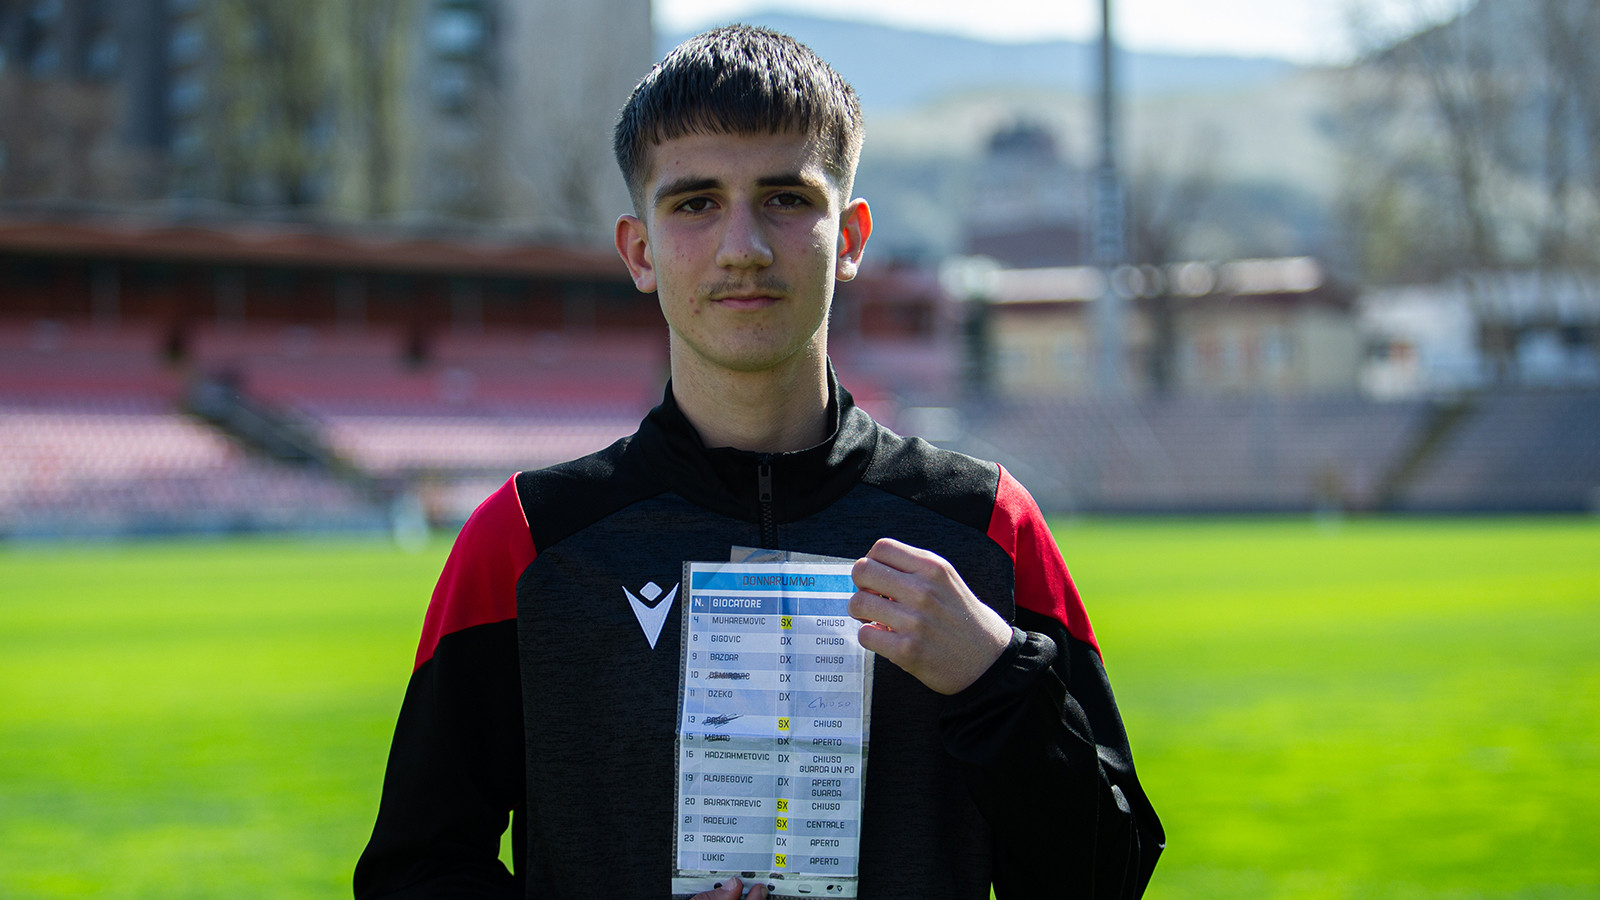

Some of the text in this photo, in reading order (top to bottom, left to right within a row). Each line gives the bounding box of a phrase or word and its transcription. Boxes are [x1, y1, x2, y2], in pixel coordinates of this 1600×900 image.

[743, 576, 815, 587] DONNARUMMA
[695, 599, 761, 608] N. GIOCATORE
[712, 617, 766, 625] MUHAREMOVIC
[781, 618, 792, 627] SX
[780, 637, 792, 645] DX
[780, 656, 791, 664] DX
[815, 656, 844, 664] CHIUSO
[780, 674, 791, 682] DX
[708, 690, 732, 698] DZEKO
[779, 693, 790, 701] DX
[778, 720, 789, 728] SX
[813, 720, 842, 728] CHIUSO
[813, 738, 842, 746] APERTO
[704, 752, 769, 761] HADZIAHMETOVIC
[778, 754, 789, 763] DX
[813, 755, 841, 763] CHIUSO
[800, 765, 829, 773] GUARDA
[704, 775, 753, 783] ALAJBEGOVIC
[778, 778, 789, 786] DX
[812, 779, 841, 787] APERTO
[812, 789, 841, 797] GUARDA
[704, 798, 761, 807] BAJRAKTAREVIC
[777, 801, 788, 809] SX
[703, 817, 737, 825] RADELJIC
[776, 820, 787, 828] SX
[807, 821, 845, 829] CENTRALE
[703, 835, 744, 843] TABAKOVIC
[776, 838, 787, 846] DX
[810, 839, 839, 847] APERTO
[776, 856, 786, 864] SX
